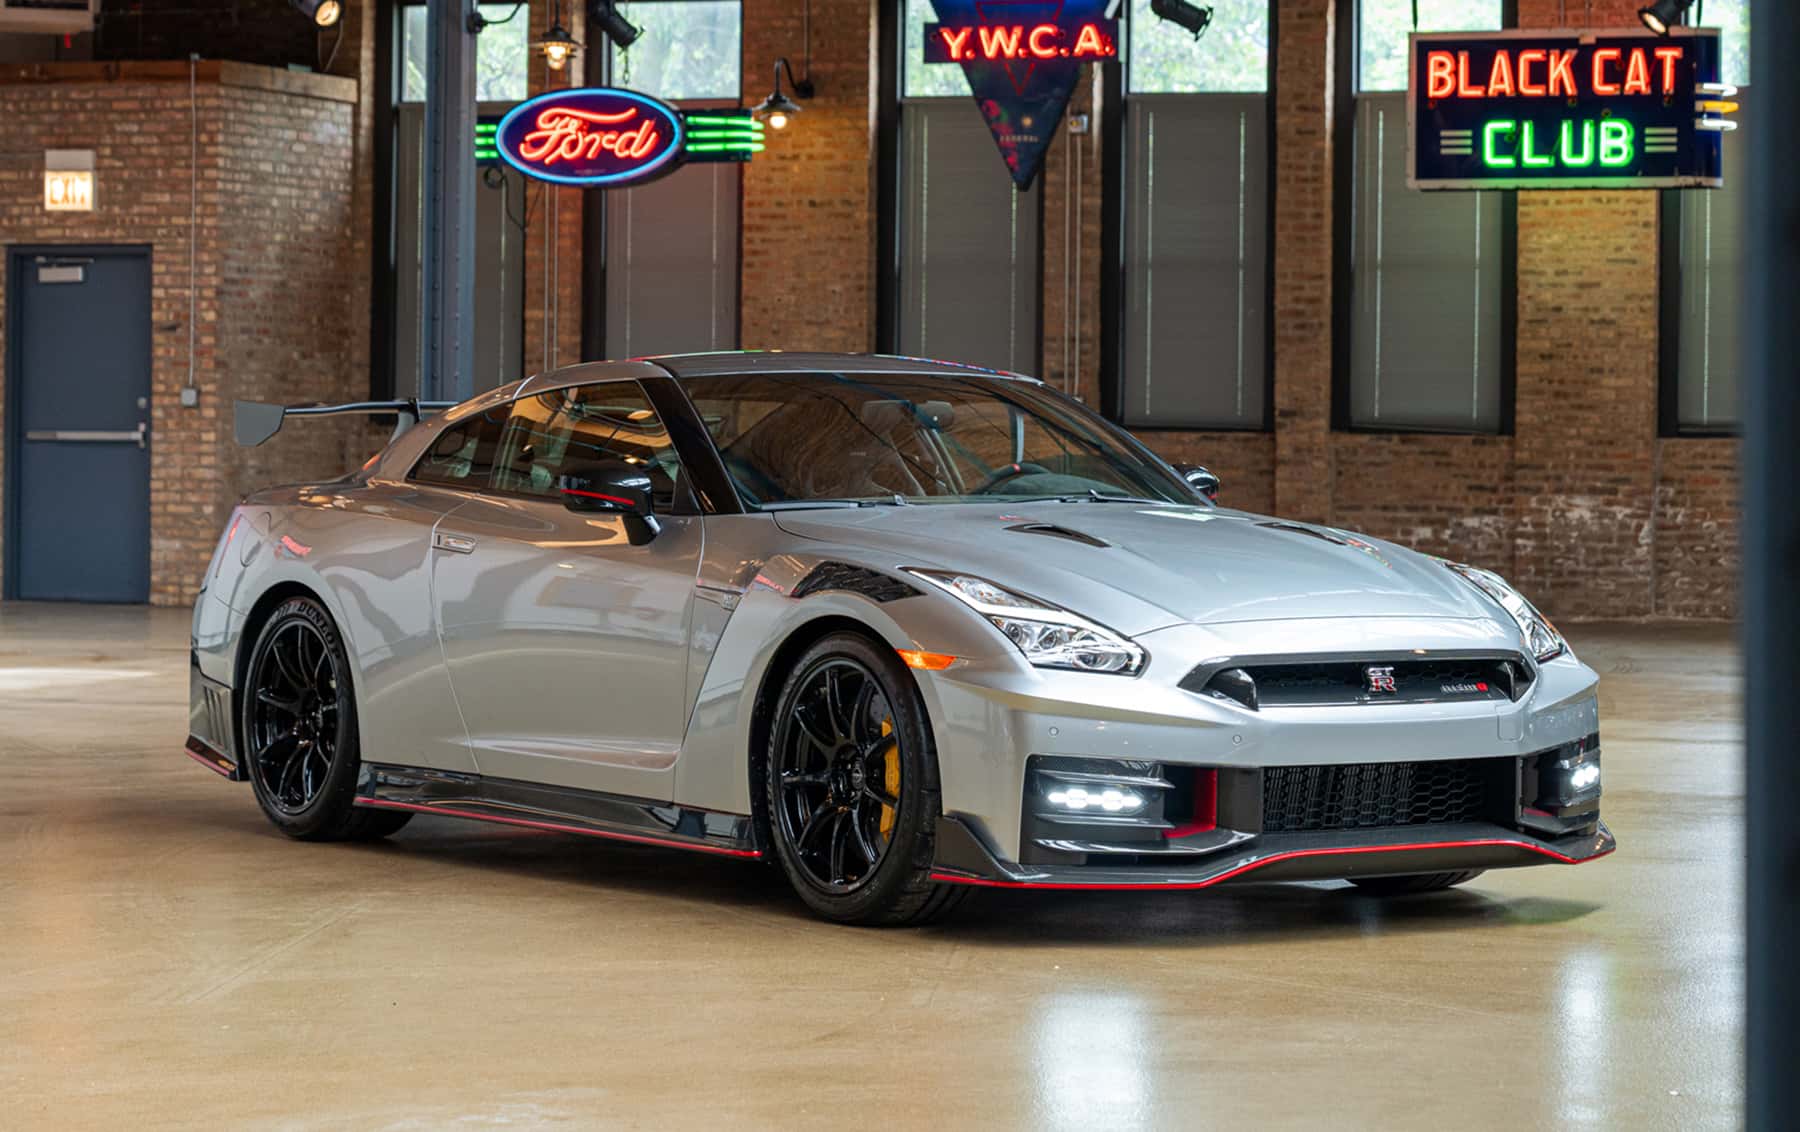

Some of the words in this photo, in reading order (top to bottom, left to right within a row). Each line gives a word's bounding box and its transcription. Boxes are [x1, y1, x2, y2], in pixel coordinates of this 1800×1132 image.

[939, 23, 1116, 60] Y.W.C.A.
[1427, 49, 1578, 98] BLACK
[1591, 47, 1684, 97] CAT
[519, 107, 661, 165] Ford
[1483, 119, 1635, 168] CLUB
